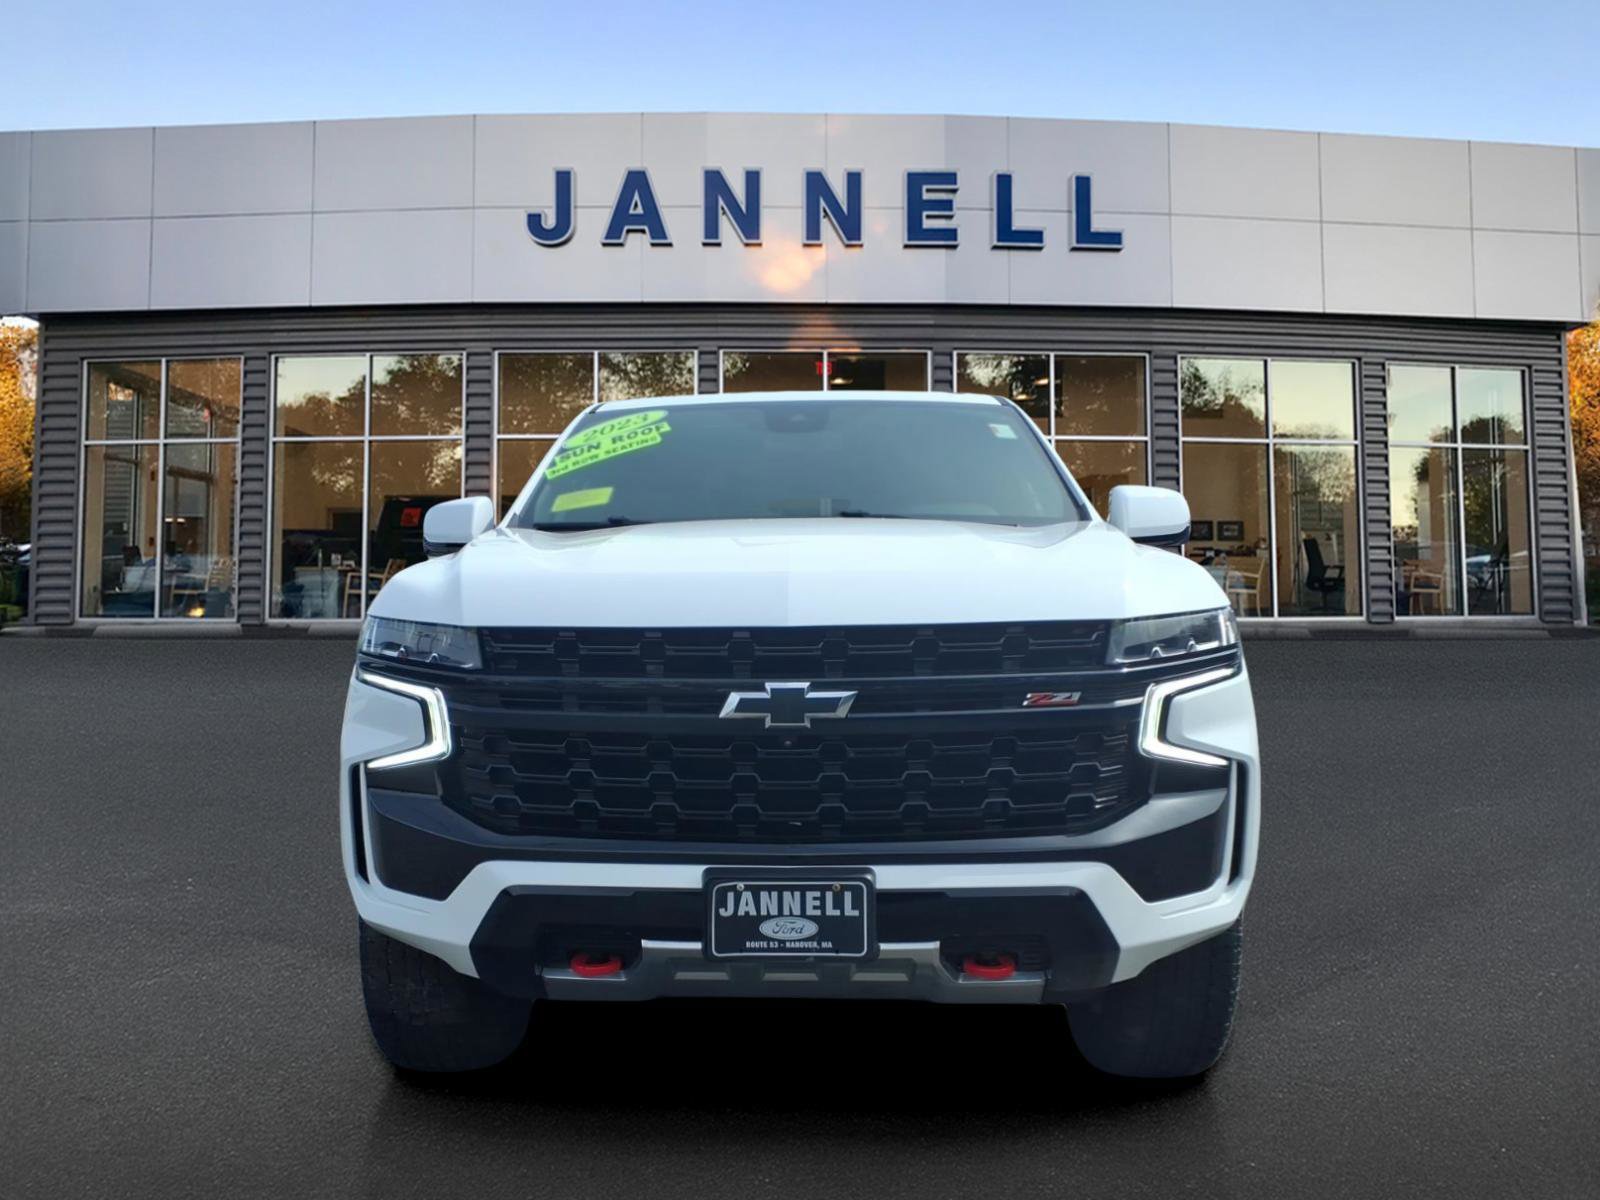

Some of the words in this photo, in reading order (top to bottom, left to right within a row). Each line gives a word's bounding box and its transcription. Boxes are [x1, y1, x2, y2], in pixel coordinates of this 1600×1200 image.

[526, 167, 1124, 252] JANNELL
[583, 413, 649, 443] 2023
[559, 442, 601, 463] SUN
[611, 424, 665, 444] ROOF
[604, 435, 658, 455] SEATING
[719, 891, 860, 917] JANNELL
[771, 920, 804, 935] Ford
[746, 941, 768, 949] ROUTE
[821, 941, 833, 949] MA
